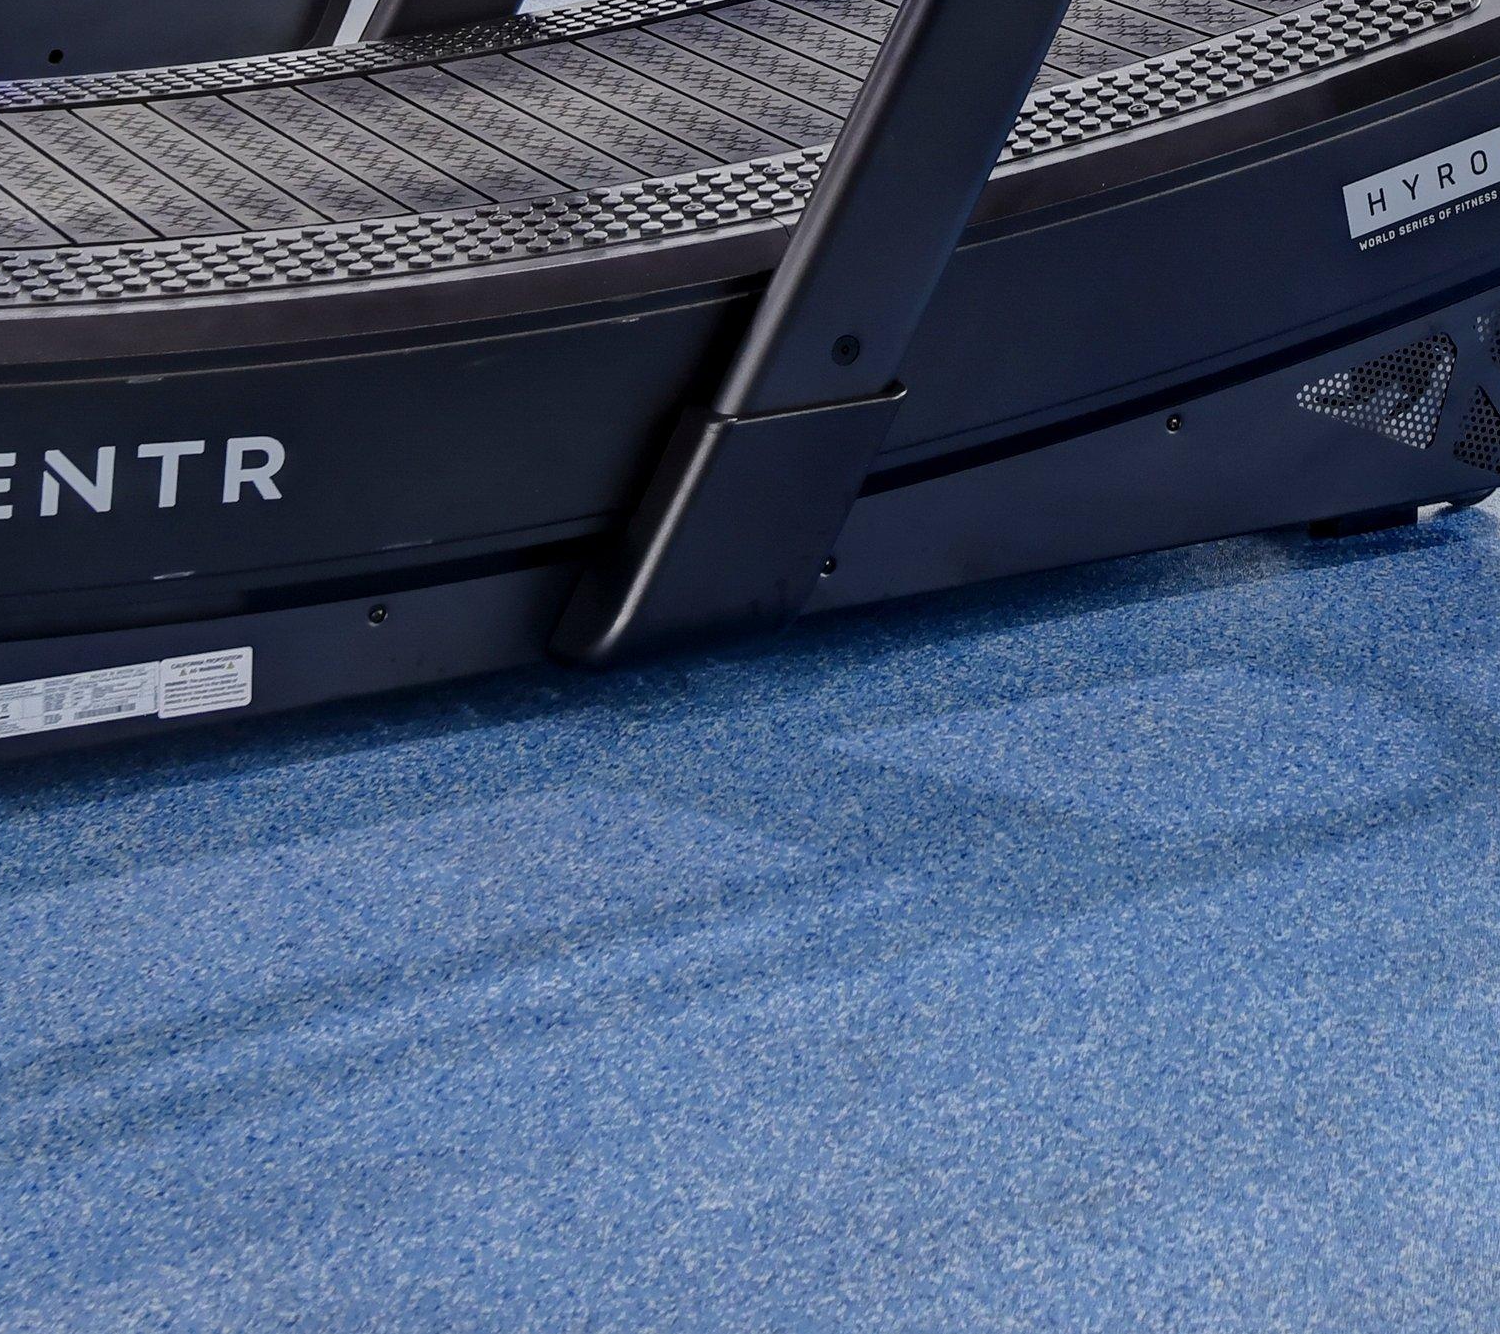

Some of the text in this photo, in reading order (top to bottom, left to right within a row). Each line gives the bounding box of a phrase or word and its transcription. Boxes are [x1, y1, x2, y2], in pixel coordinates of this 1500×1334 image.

[1358, 229, 1396, 252] WORLD
[1398, 214, 1436, 237] SERIES
[1438, 206, 1453, 221] OF
[1454, 189, 1499, 214] FITNESS
